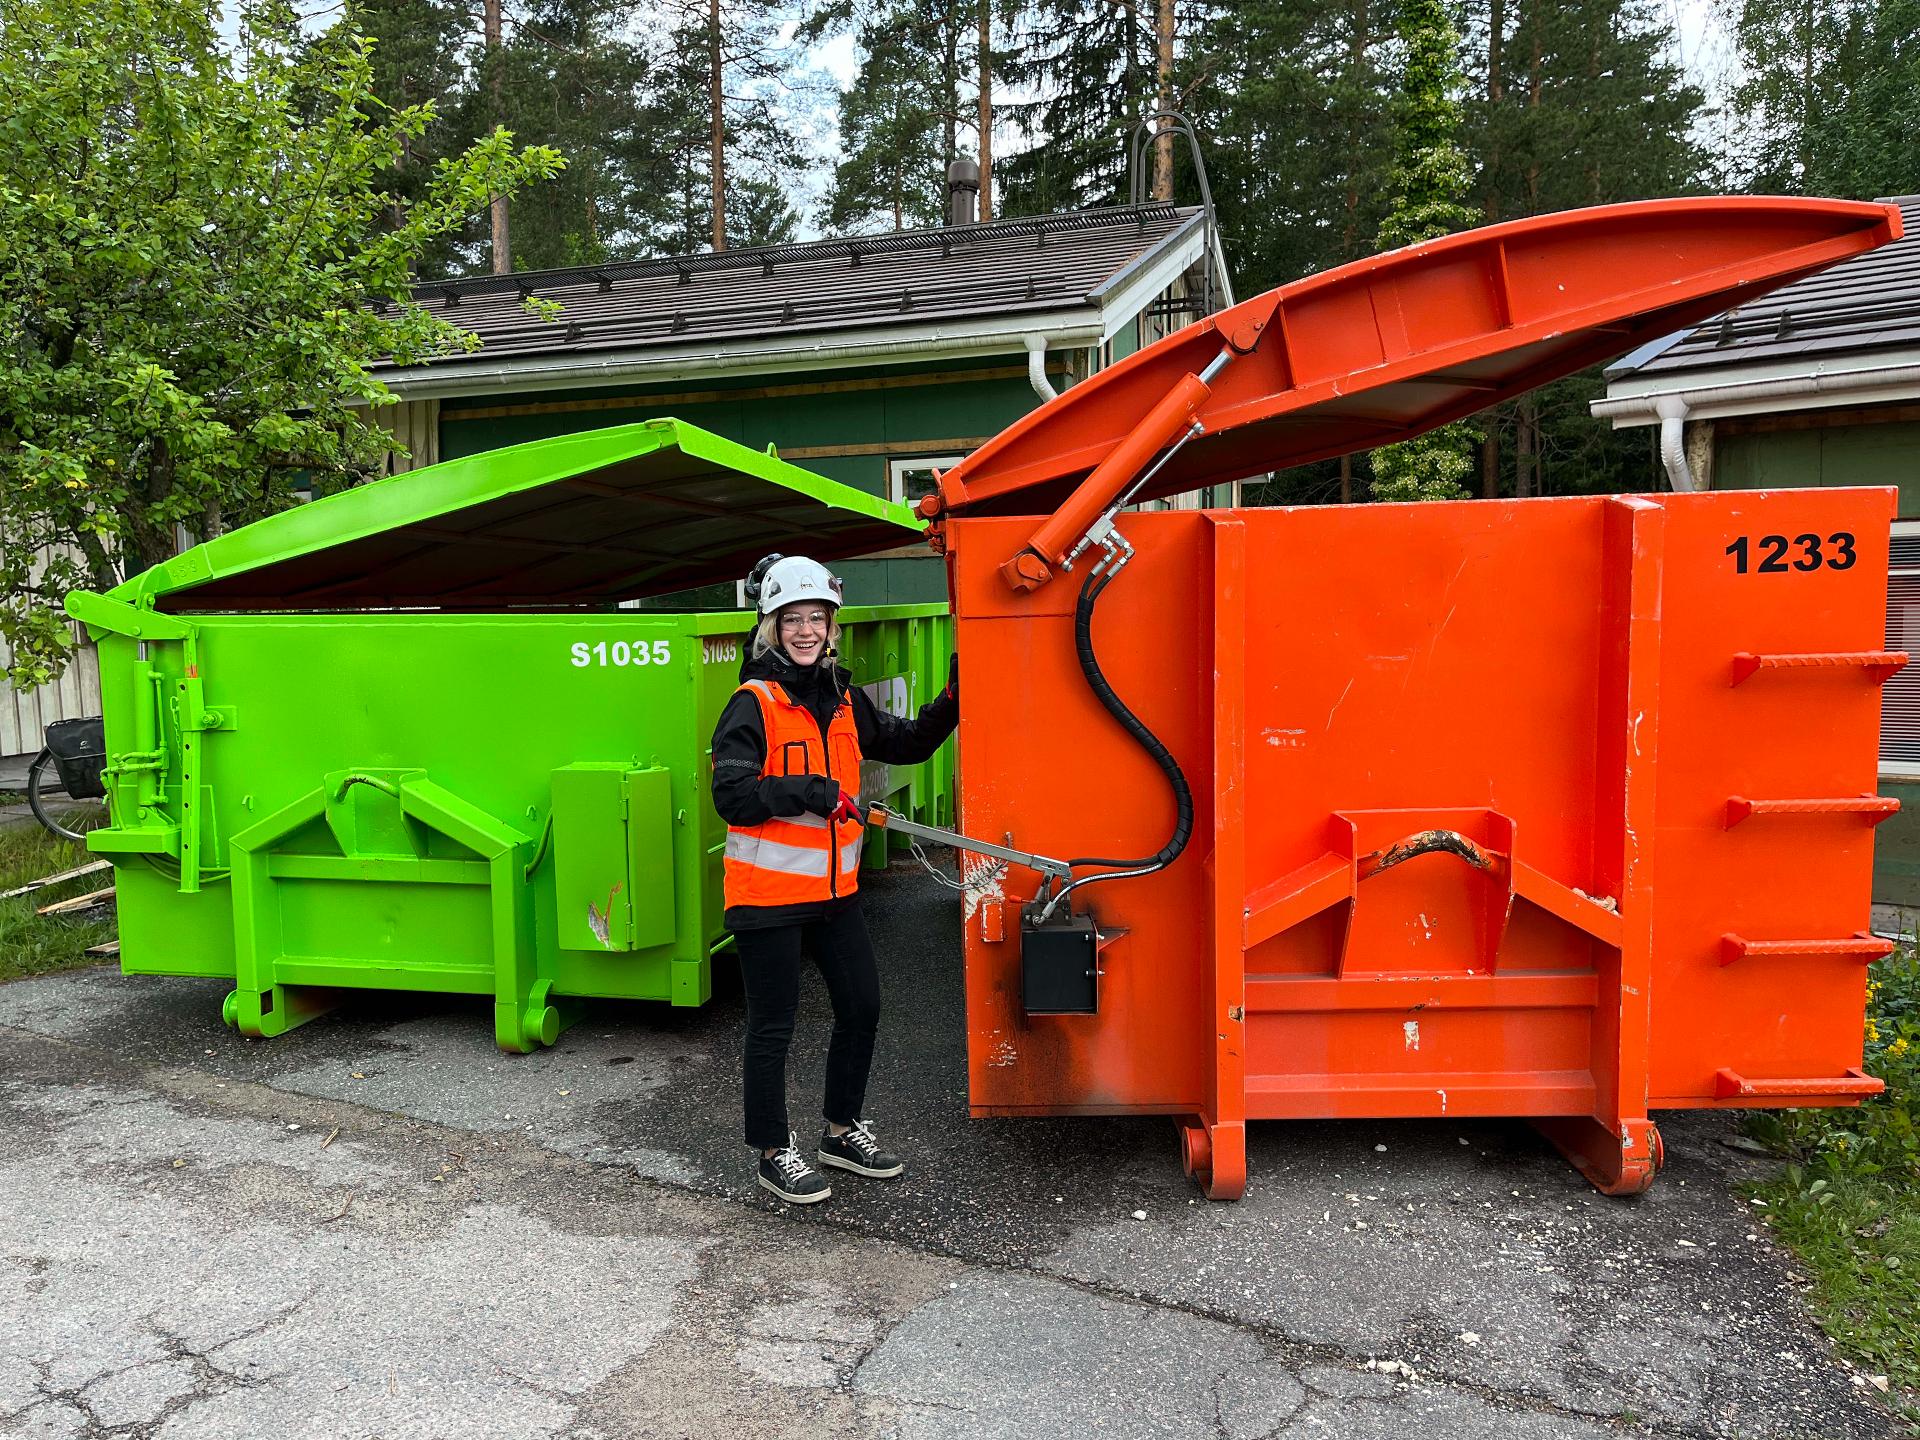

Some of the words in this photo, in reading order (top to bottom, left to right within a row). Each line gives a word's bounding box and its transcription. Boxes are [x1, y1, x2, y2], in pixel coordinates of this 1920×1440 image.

[1725, 532, 1857, 574] 1233
[570, 640, 671, 668] S1035
[702, 639, 737, 665] S1035
